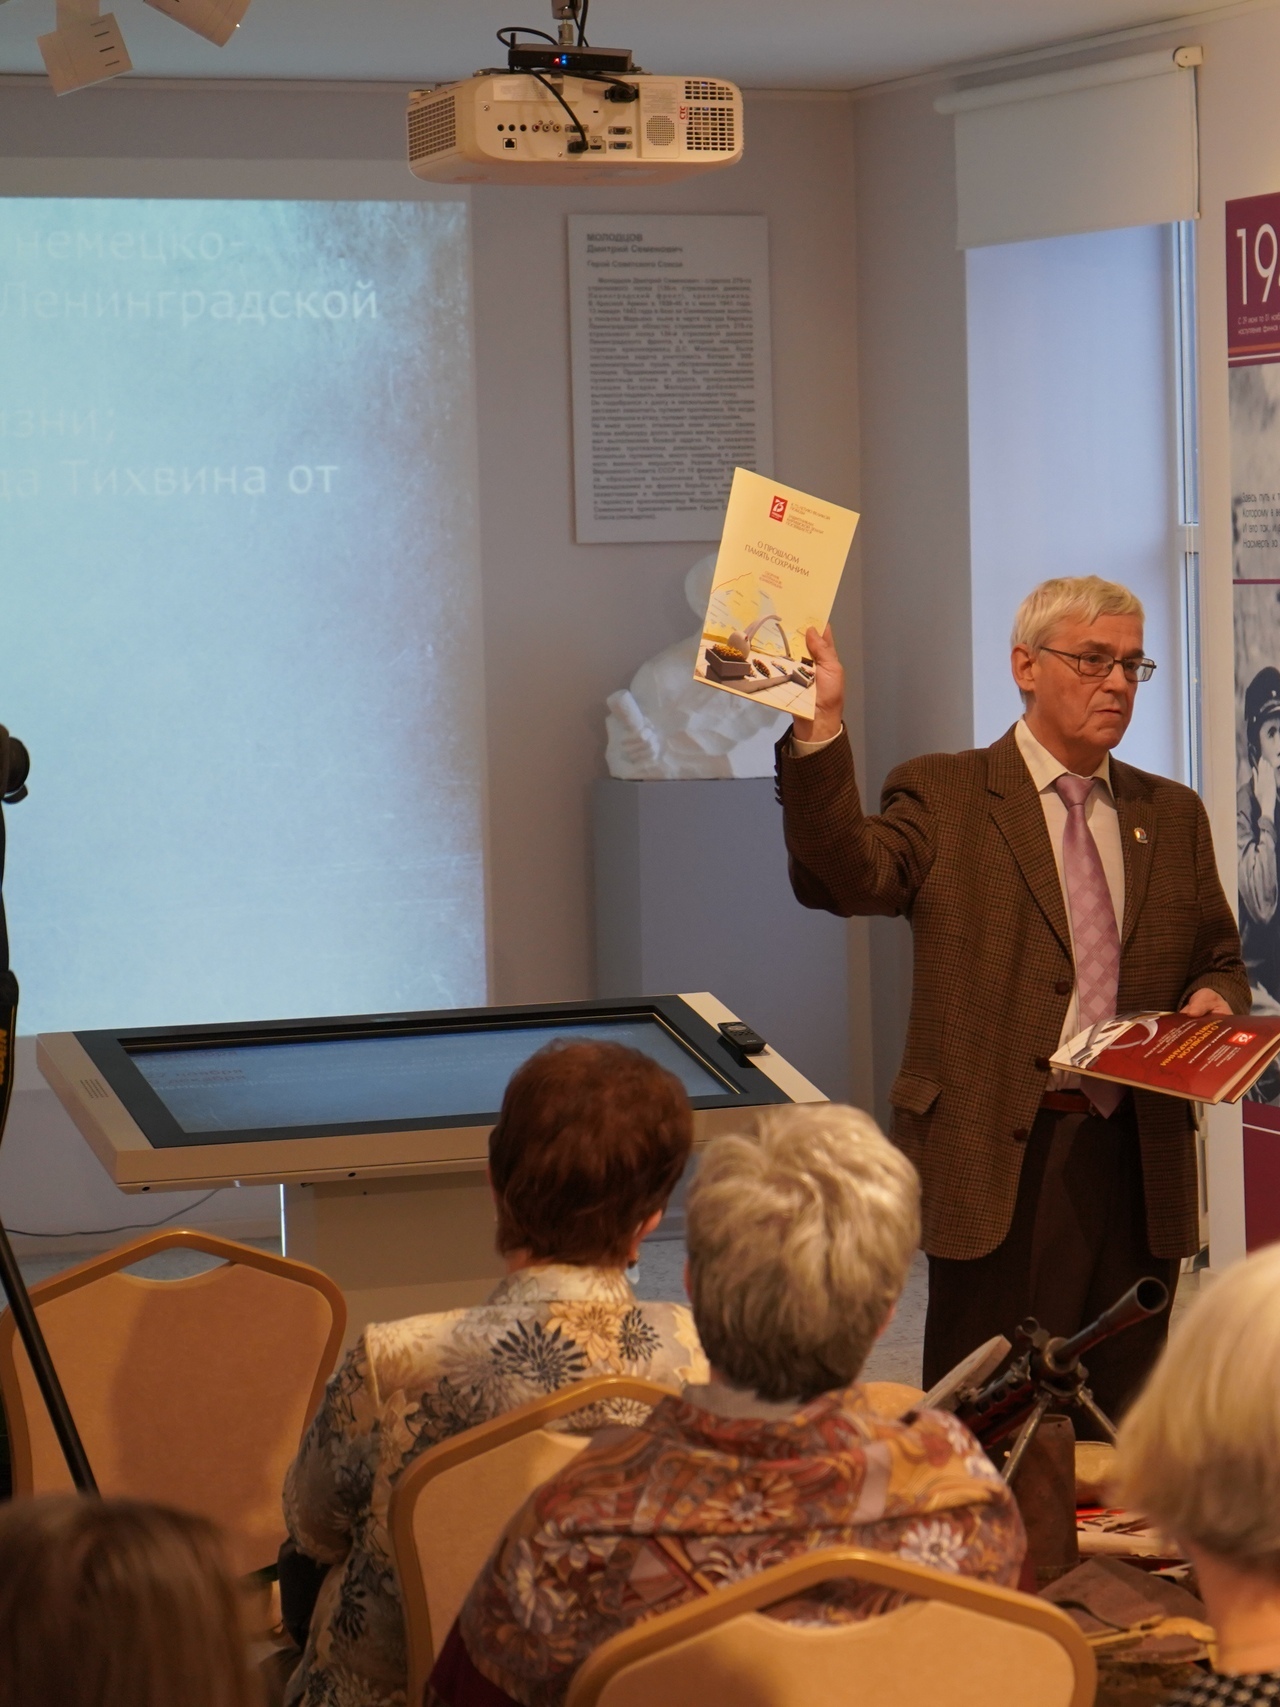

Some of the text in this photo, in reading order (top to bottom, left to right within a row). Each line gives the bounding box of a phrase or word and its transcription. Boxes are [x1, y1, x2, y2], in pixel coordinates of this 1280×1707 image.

[16, 230, 245, 265] немецко-
[0, 279, 379, 327] Ленинградской
[60, 459, 268, 496] Тихвина
[288, 464, 340, 496] от
[745, 544, 810, 577] ПАМЯТЬ СОХРАНИМ
[764, 543, 800, 564] ПРОШЛОМ
